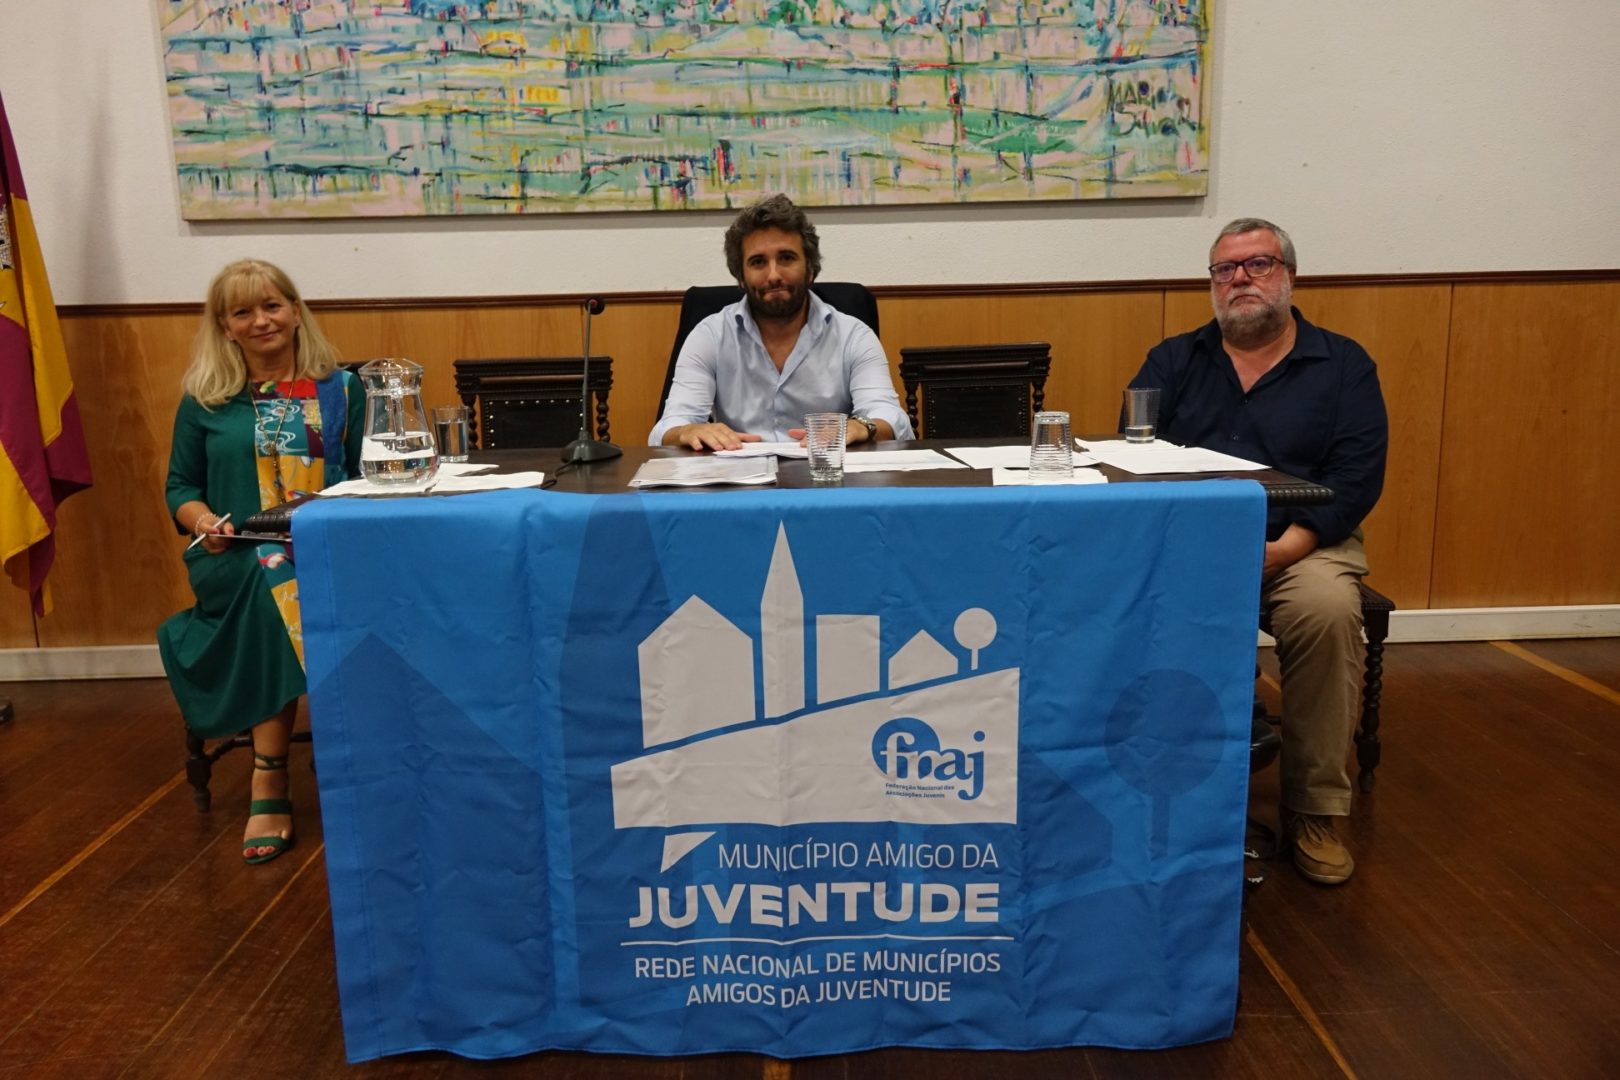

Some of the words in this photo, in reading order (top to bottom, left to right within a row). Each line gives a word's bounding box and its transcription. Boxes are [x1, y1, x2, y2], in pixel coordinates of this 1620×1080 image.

[878, 729, 985, 801] fnaj
[718, 837, 858, 872] MUNICÍPIO
[865, 841, 955, 869] AMIGO
[962, 843, 999, 869] DA
[629, 881, 1000, 928] JUVENTUDE
[635, 956, 696, 979] REDE
[703, 954, 819, 979] NACIONAL
[826, 952, 856, 973] DE
[863, 948, 1001, 973] MUNICÍPIOS
[686, 982, 775, 1006] AMIGOS
[781, 987, 810, 1008] DA
[815, 978, 951, 1004] JUVENTUDE
